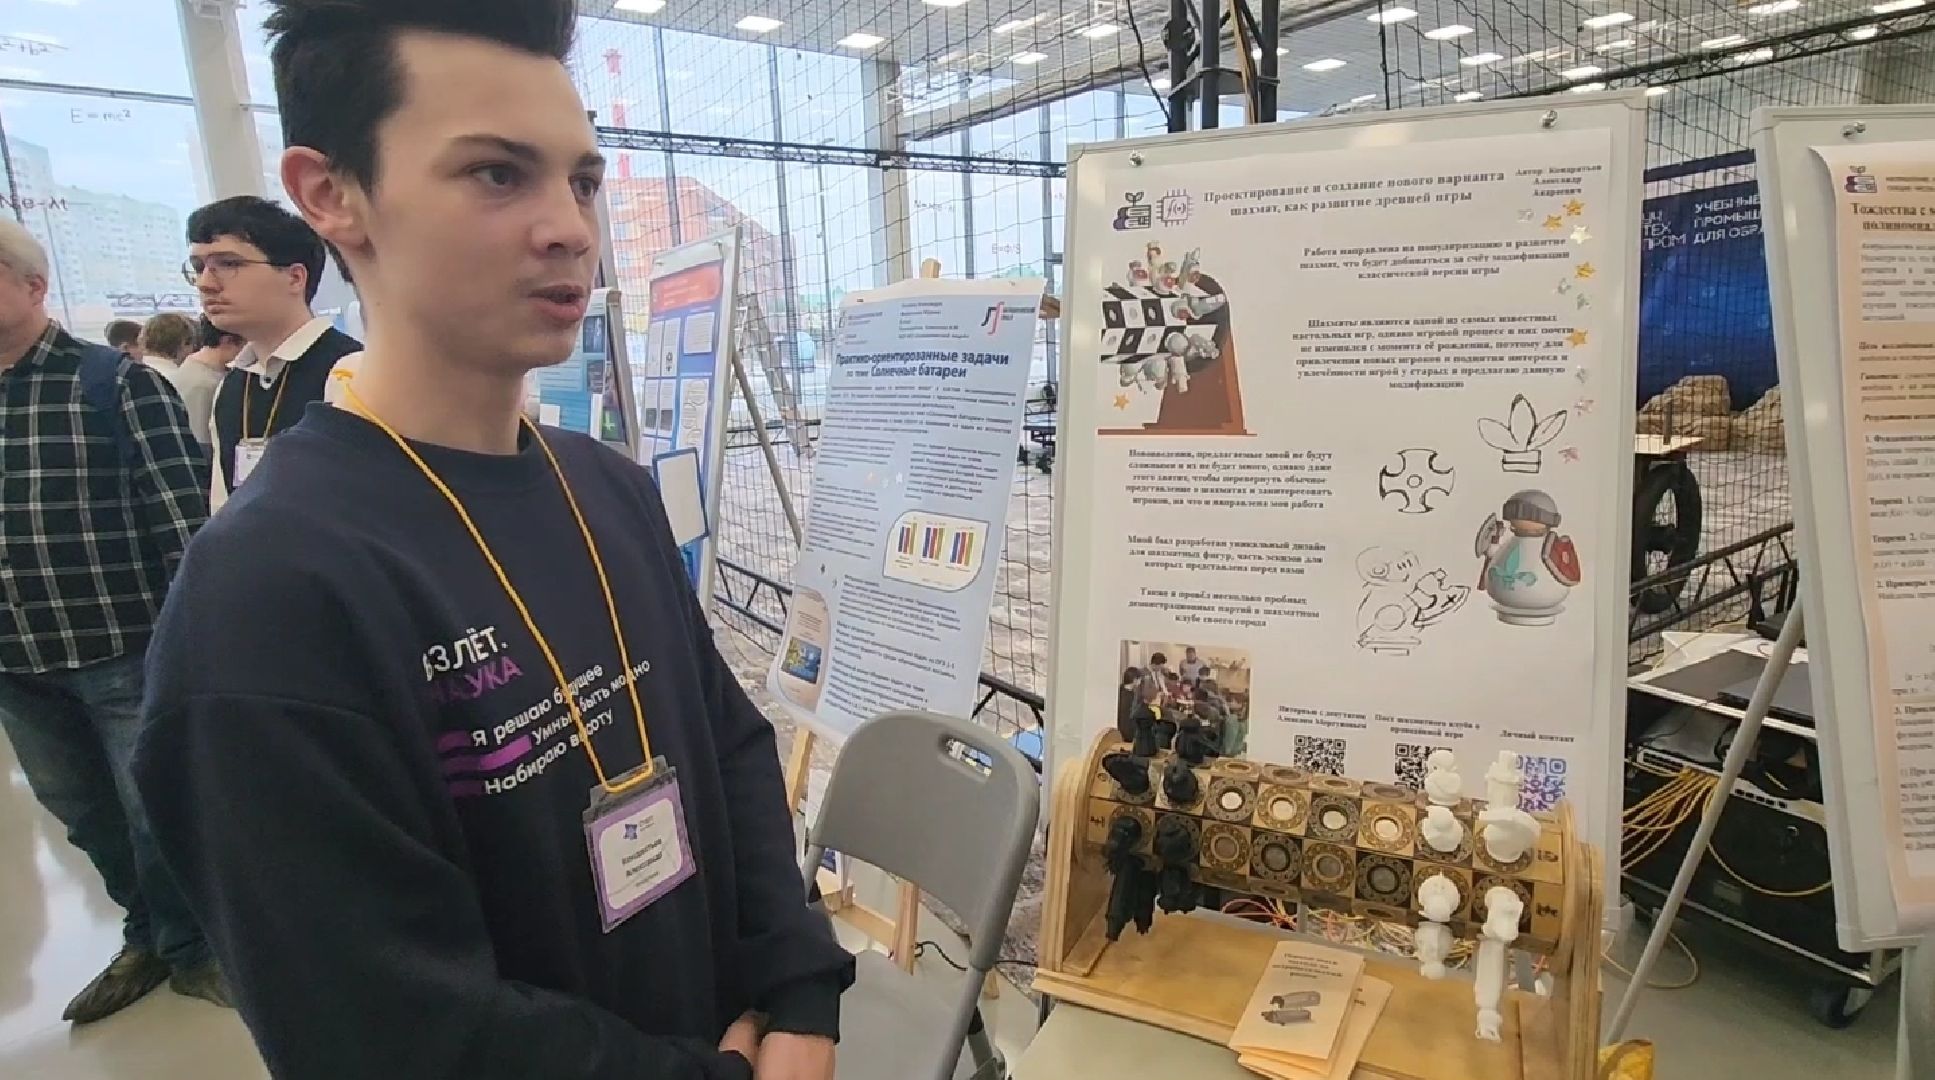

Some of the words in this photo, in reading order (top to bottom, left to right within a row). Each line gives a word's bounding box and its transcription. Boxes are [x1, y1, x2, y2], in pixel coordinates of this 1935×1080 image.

[1203, 186, 1310, 204] Проектирование
[1312, 184, 1321, 194] и
[1324, 180, 1383, 192] создание
[1387, 177, 1433, 188] нового
[1437, 172, 1505, 187] варианта
[1230, 203, 1281, 216] шахмат,
[1284, 202, 1308, 213] как
[1311, 199, 1372, 213] развитие
[1374, 192, 1430, 208] древней
[1435, 192, 1472, 204] игры
[1850, 202, 1917, 216] Тождества
[1694, 228, 1726, 245] ДЛЯ
[1728, 224, 1761, 239] ОБР
[1303, 247, 1337, 257] Работа
[1340, 245, 1399, 257] направлена
[1417, 241, 1503, 254] популяризацию
[1505, 240, 1512, 248] и
[1515, 239, 1566, 249] развитие
[1342, 260, 1360, 268] что
[1361, 257, 1388, 268] будет
[1390, 255, 1450, 266] добиваться
[1453, 256, 1464, 264] за
[1466, 253, 1489, 263] счёт
[1492, 251, 1570, 263] модификации
[1358, 268, 1429, 279] классической
[1431, 267, 1469, 277] версии
[1471, 266, 1500, 276] игры
[1308, 319, 1357, 328] Шахматы
[1413, 316, 1444, 325] одной
[1499, 315, 1557, 323] известных
[1292, 332, 1351, 340] настольных
[1416, 328, 1459, 338] игровой
[1462, 328, 1504, 337] процесс
[1377, 344, 1421, 352] момента
[1495, 341, 1540, 351] поэтому
[961, 352, 1009, 366] задачи
[1296, 358, 1360, 367] привлечения
[1453, 355, 1504, 363] поднятия
[1507, 354, 1558, 364] интереса
[871, 365, 918, 377] Солнечные
[918, 363, 967, 380] батареи
[1298, 368, 1367, 379] увлечённости
[1369, 367, 1399, 377] игрой
[1401, 369, 1407, 377] у
[1410, 367, 1449, 377] старых
[1460, 367, 1520, 376] предлагаю
[1522, 367, 1566, 376] данную
[1389, 380, 1464, 391] модификацию
[1196, 450, 1262, 459] предлагаемые
[1265, 450, 1290, 459] мной
[1306, 451, 1332, 462] будут
[1211, 461, 1236, 472] будет
[1132, 474, 1156, 482] этого
[1192, 473, 1220, 482] чтобы
[1222, 475, 1282, 485] перевернуть
[1284, 475, 1326, 484] обычное
[1125, 484, 1191, 493] представление
[1258, 487, 1333, 497] заинтересовать
[1213, 499, 1269, 508] направлена
[1291, 500, 1324, 510] работа
[1128, 535, 1152, 544] Мной
[1155, 536, 1173, 545] был
[1175, 538, 1227, 547] разработан
[1229, 540, 1290, 550] уникальный
[1292, 542, 1326, 552] дизайн
[1148, 550, 1200, 559] шахматных
[1202, 551, 1235, 561] фигур,
[1237, 553, 1265, 561] часть
[1144, 560, 1183, 570] которых
[1186, 562, 1248, 572] представлена
[1250, 565, 1277, 575] перед
[1140, 587, 1168, 597] Также
[1178, 590, 1212, 600] провёл
[1213, 592, 1262, 602] несколько
[1264, 594, 1308, 605] пробных
[1128, 600, 1215, 611] демонстрационных
[1217, 605, 1252, 615] партий
[1263, 608, 1320, 619] шахматном
[1175, 613, 1201, 625] клубе
[1203, 616, 1234, 625] своего
[1235, 619, 1267, 628] города
[532, 708, 583, 746] Умны
[610, 659, 651, 693] моно
[1278, 705, 1317, 716] Интервью
[472, 729, 488, 747] Я
[493, 698, 551, 746] решаю
[1396, 717, 1446, 727] шахматного
[1448, 720, 1473, 730] клуба
[1444, 730, 1465, 739] игре
[1500, 729, 1536, 740] Личный
[1538, 733, 1575, 743] контакт
[484, 741, 567, 795] Набираю
[569, 707, 614, 748] всоту
